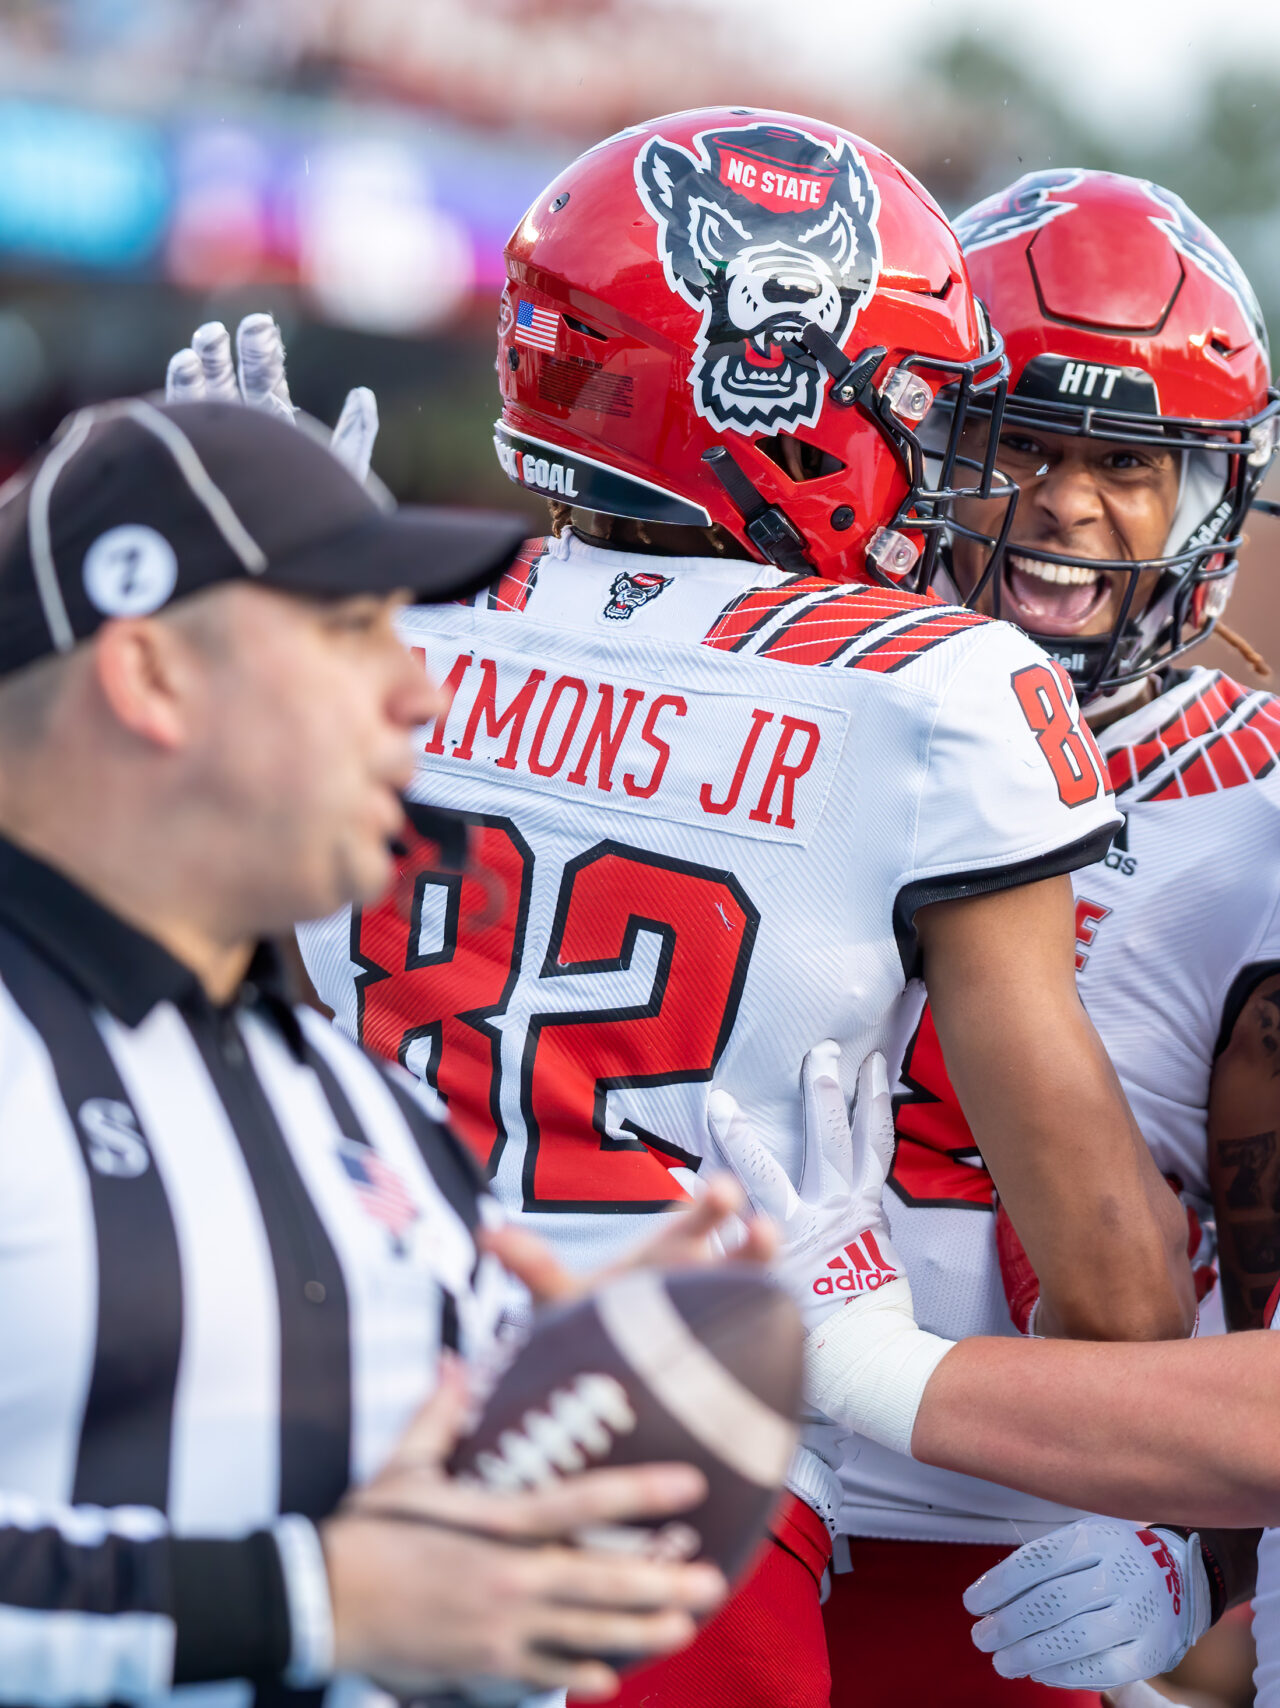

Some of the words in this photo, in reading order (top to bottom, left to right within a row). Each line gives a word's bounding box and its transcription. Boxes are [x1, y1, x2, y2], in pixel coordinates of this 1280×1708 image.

[727, 157, 757, 188] NC
[760, 170, 822, 204] STATE
[1058, 362, 1122, 400] HTT
[410, 646, 688, 800] MMONS
[699, 708, 811, 830] JR
[350, 803, 761, 1214] 82
[78, 1097, 150, 1179] S
